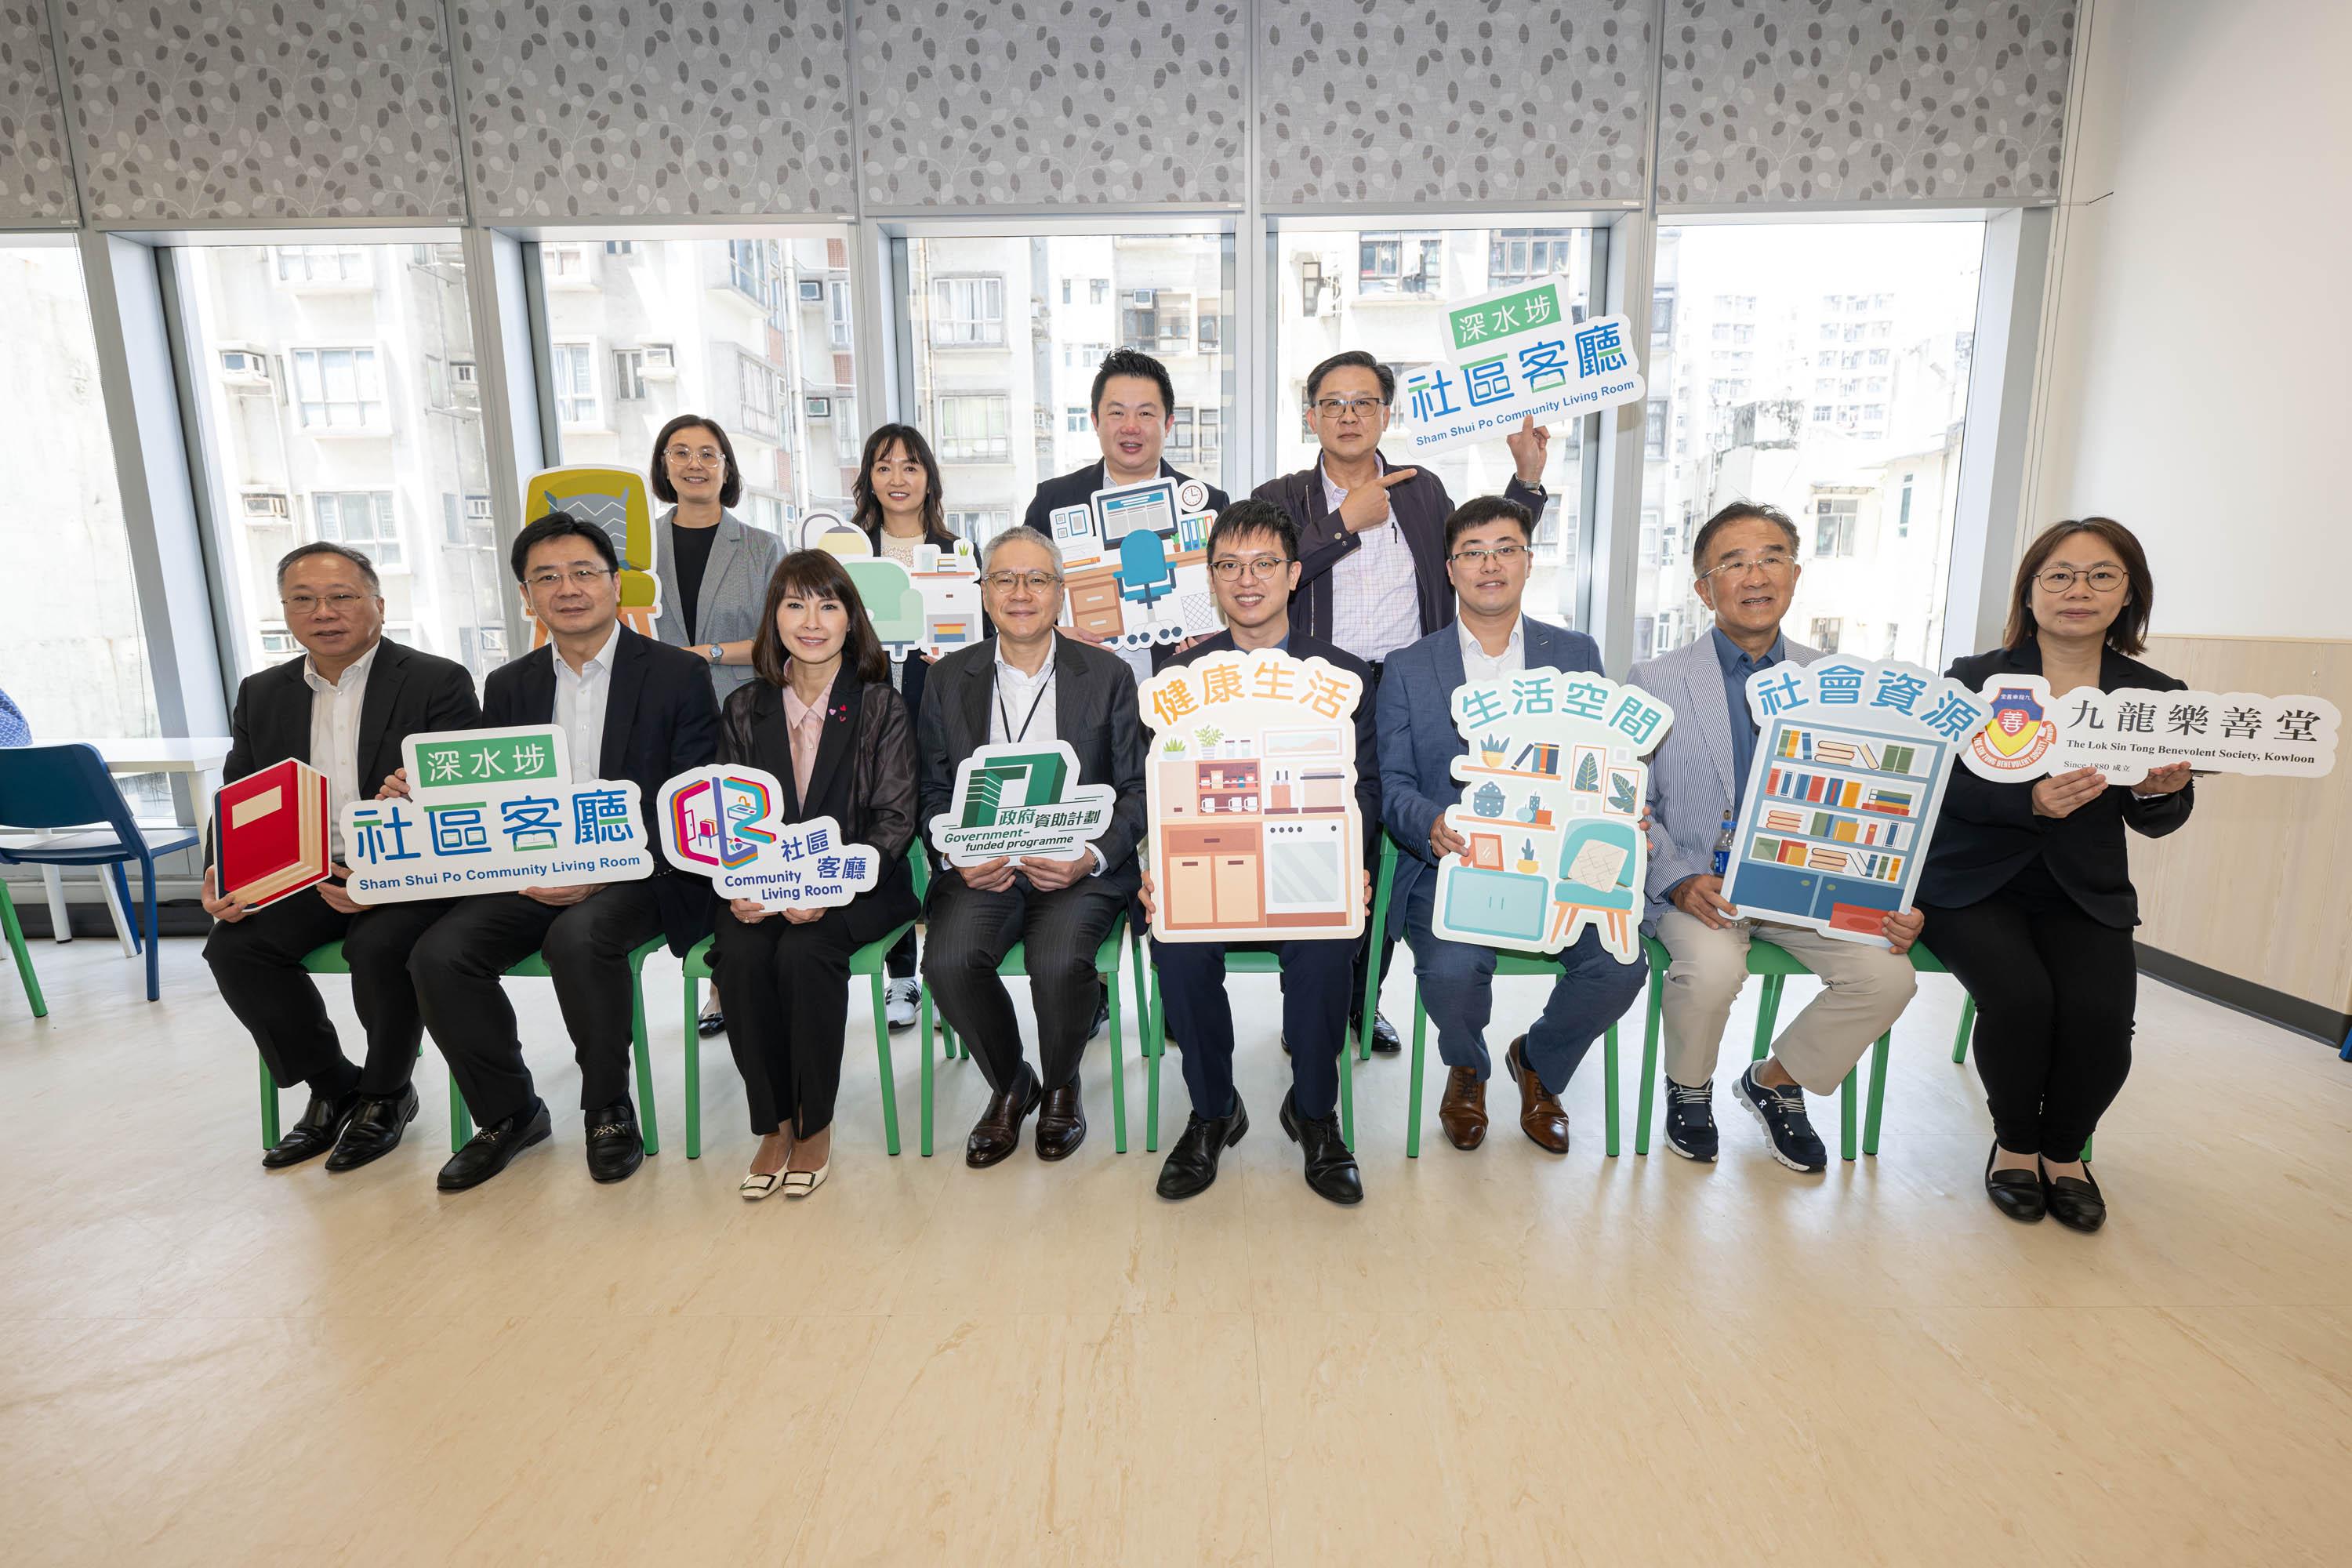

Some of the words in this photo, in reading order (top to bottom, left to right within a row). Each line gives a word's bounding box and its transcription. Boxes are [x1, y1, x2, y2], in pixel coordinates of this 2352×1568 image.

[1459, 294, 1551, 343] 深水埗
[1408, 322, 1628, 423] 社區客廳
[1416, 431, 1447, 446] Sham
[1450, 423, 1475, 436] Shui
[1479, 419, 1494, 429] Po
[1497, 400, 1559, 424] Community
[1563, 391, 1598, 406] Living
[1601, 381, 1635, 395] Room
[1152, 662, 1350, 726] 健康生活
[1462, 677, 1662, 745] 生活空間
[1757, 665, 1981, 742] 社會資源
[2067, 699, 2321, 742] 九龍樂善堂
[427, 743, 545, 782] 深水埗
[2066, 739, 2085, 749] The
[2089, 742, 2107, 750] Lok
[2129, 745, 2154, 754] Tong
[2158, 746, 2216, 757] Benevolent
[2219, 750, 2260, 761] Society,
[2264, 753, 2314, 764] Kowloon
[353, 789, 633, 864] 社區客廳
[998, 808, 1102, 829] 政府資助計劃
[781, 829, 829, 862] 社區
[965, 840, 1004, 851] funded
[1007, 836, 1073, 851] programme
[359, 877, 401, 891] Sham
[405, 873, 437, 887] Shui
[443, 871, 462, 883] Po
[466, 864, 547, 881] Community
[552, 859, 595, 873] Living
[600, 856, 640, 868] Room
[724, 870, 802, 887] Community
[817, 856, 867, 880] 客廳
[761, 887, 800, 900] Living
[805, 884, 843, 897] Room
